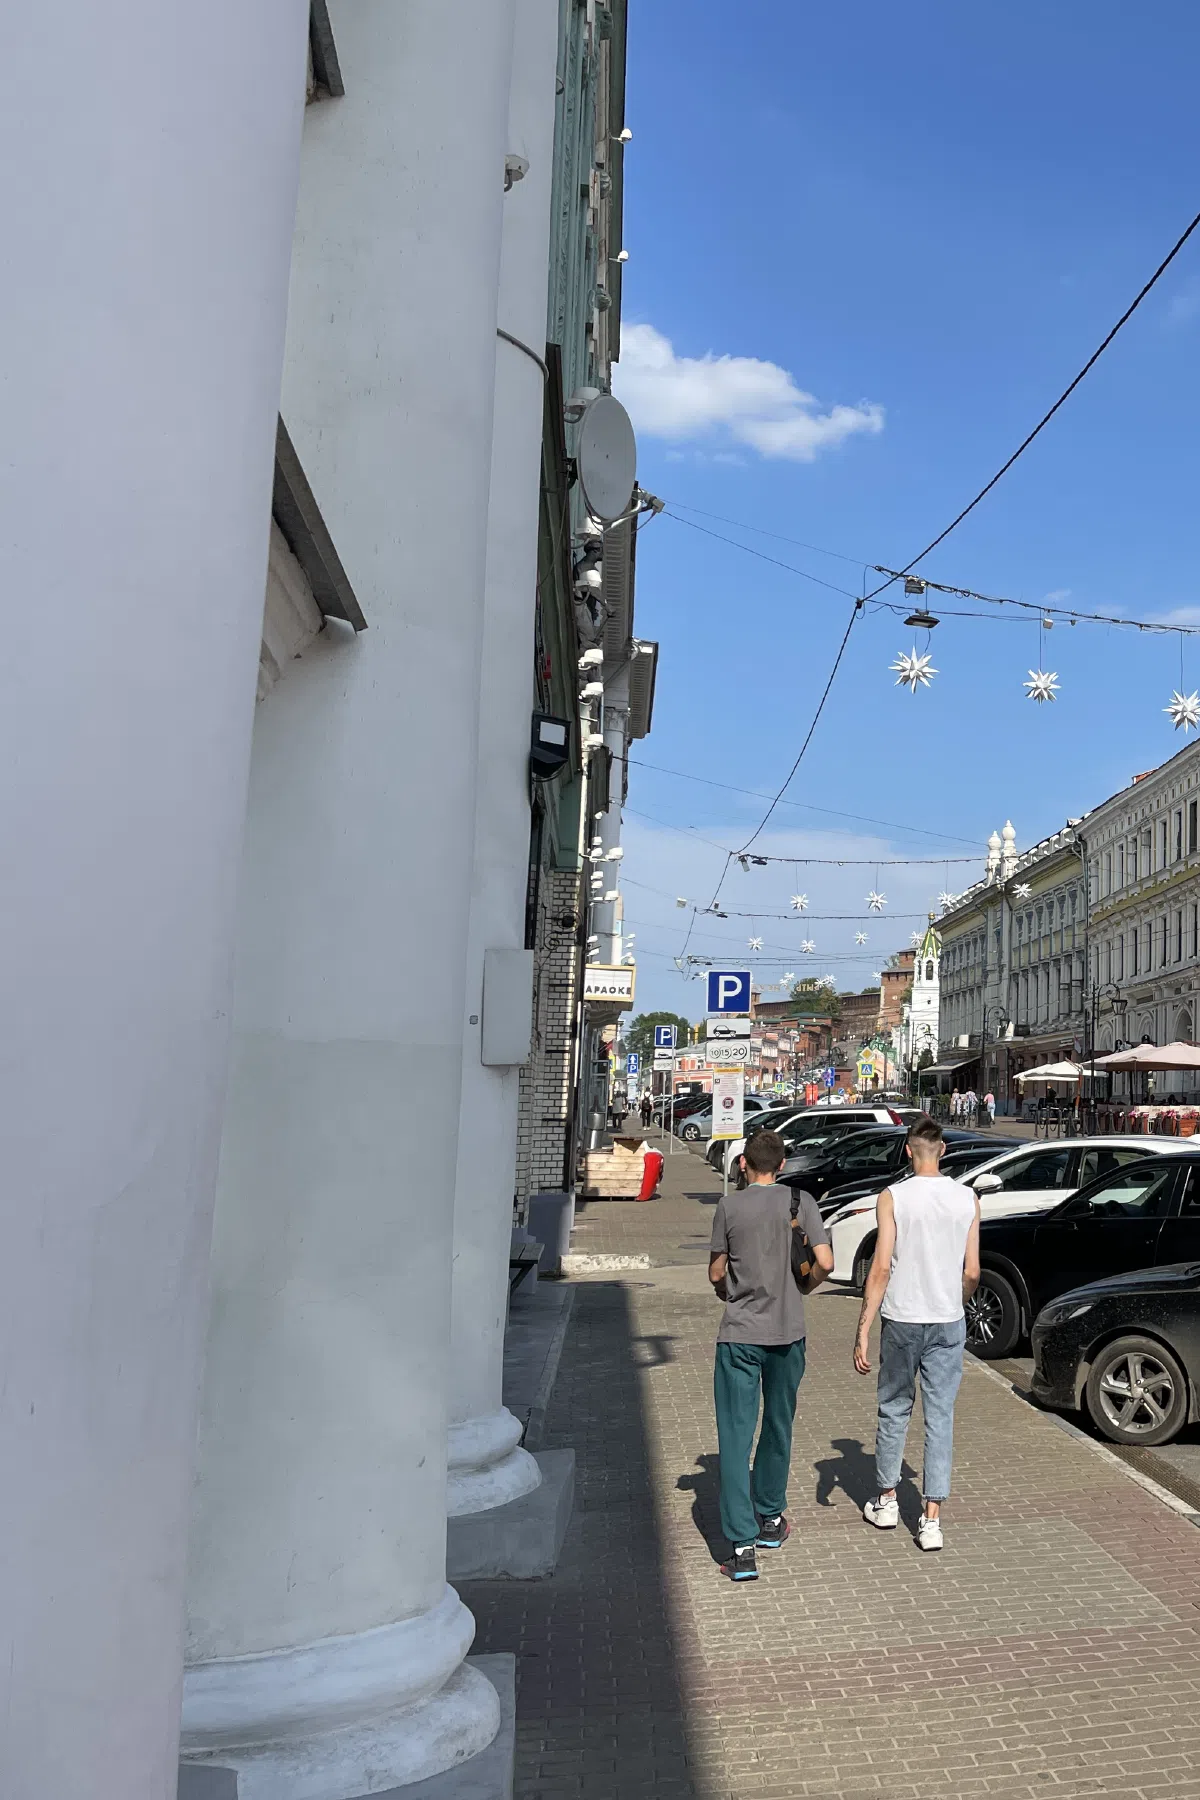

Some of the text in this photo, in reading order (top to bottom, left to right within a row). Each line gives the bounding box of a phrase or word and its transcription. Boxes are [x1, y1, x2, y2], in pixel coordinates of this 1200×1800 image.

[585, 985, 631, 995] АРАОКЕ
[718, 975, 743, 1009] P
[660, 1027, 672, 1045] P
[732, 1048, 744, 1056] 20
[629, 1064, 637, 1073] P
